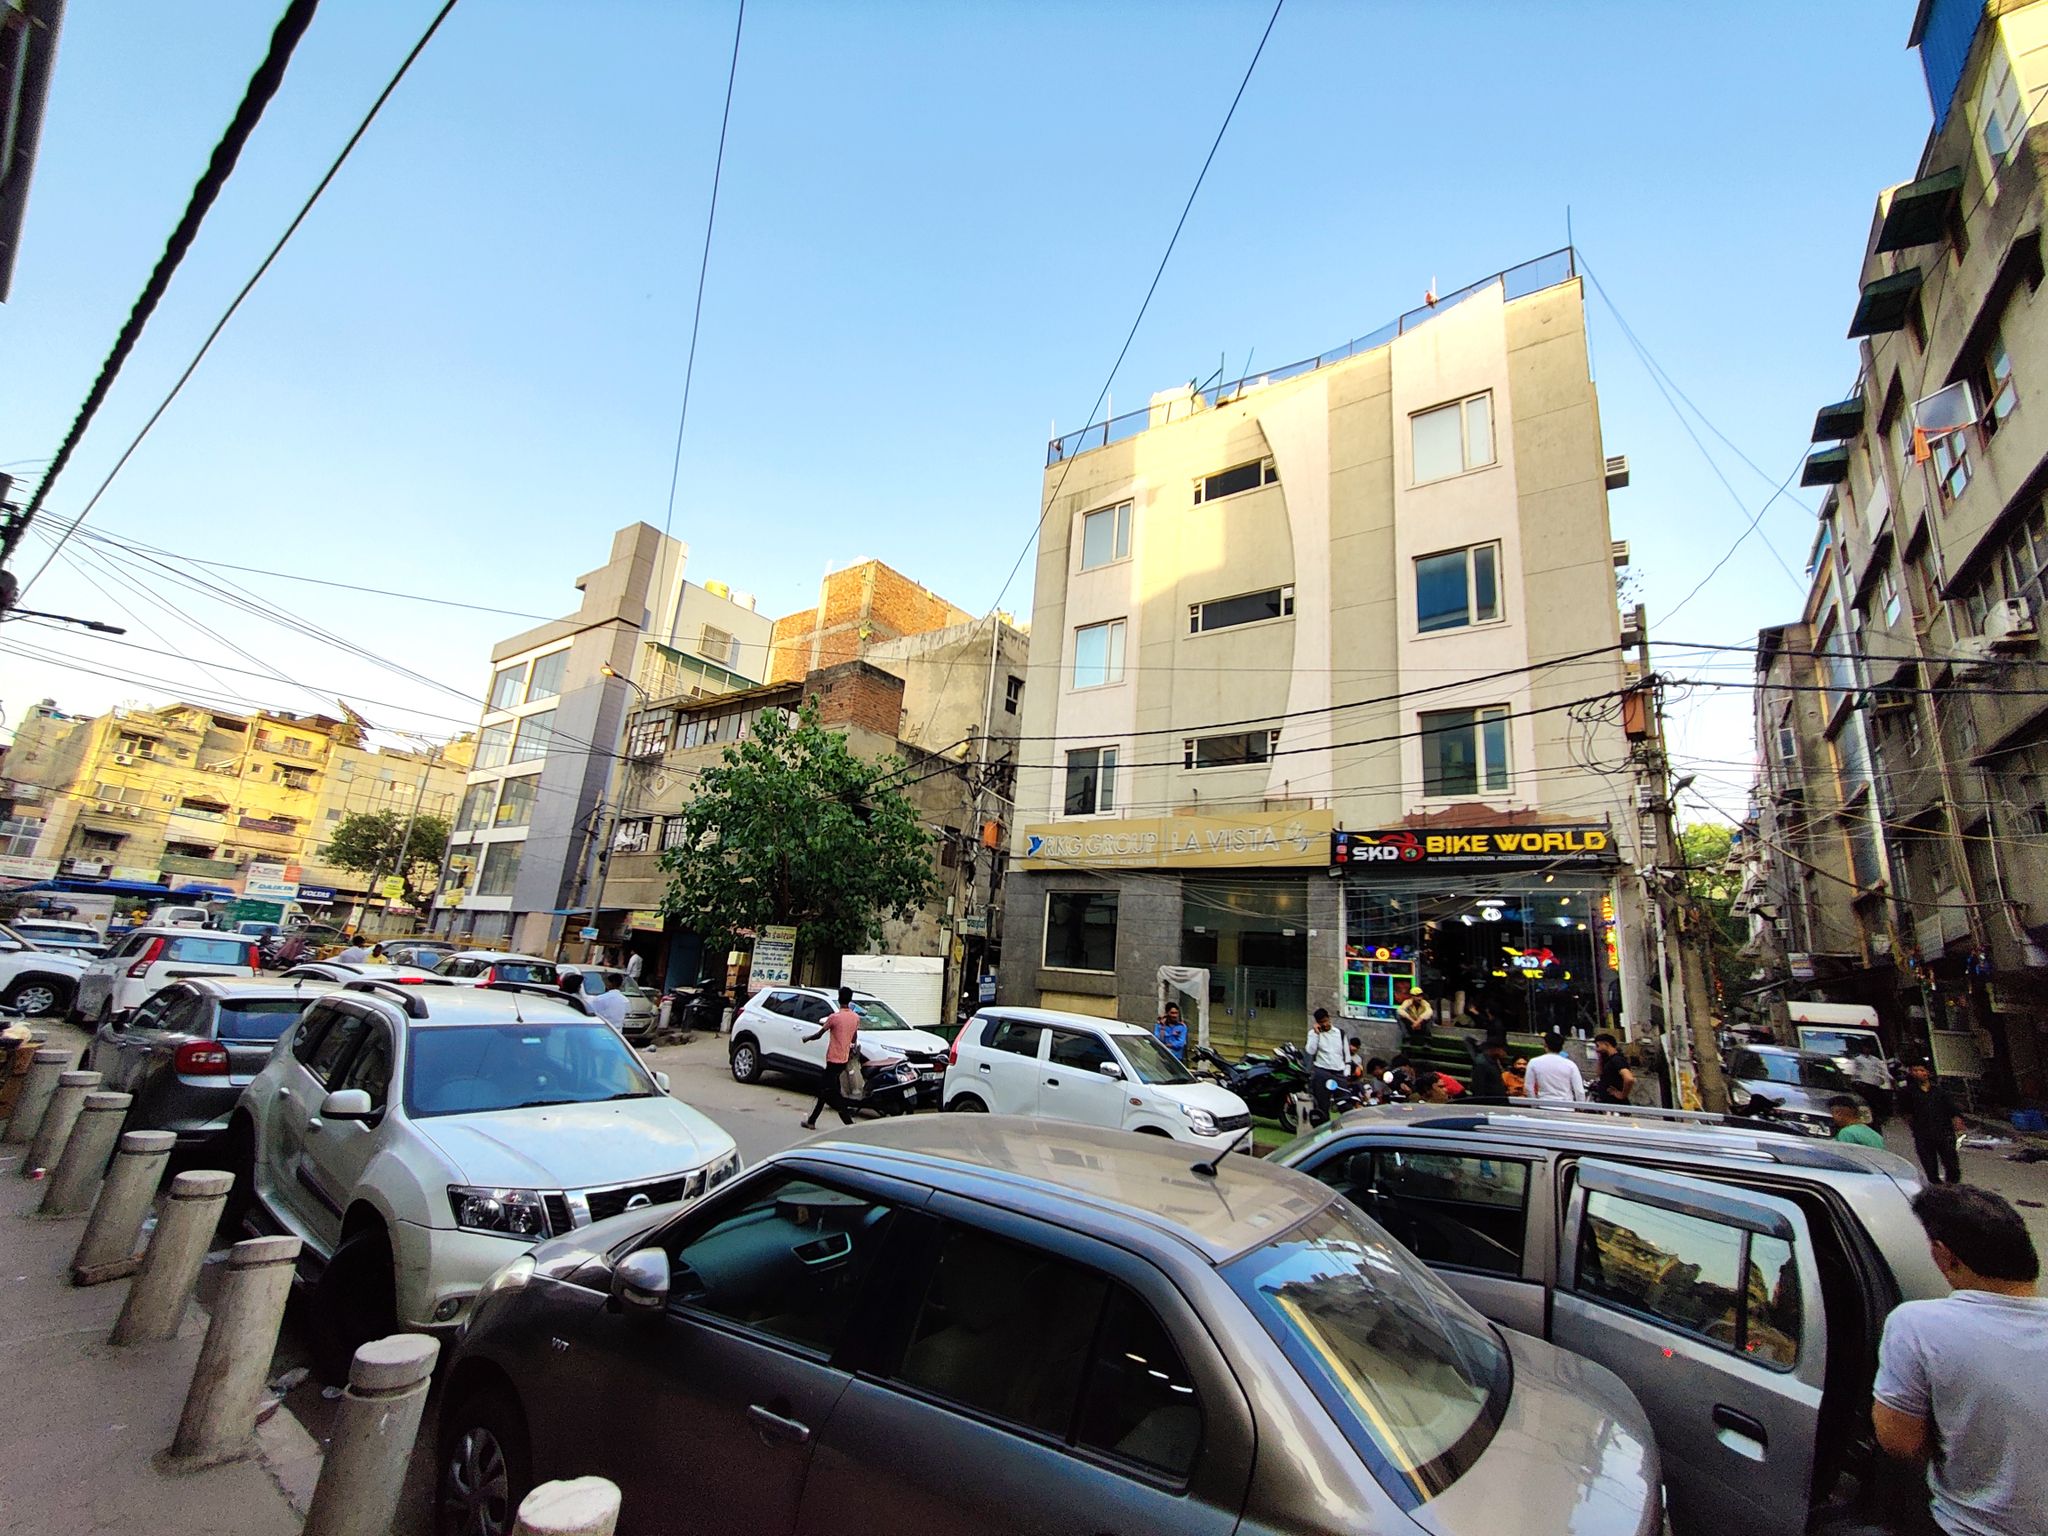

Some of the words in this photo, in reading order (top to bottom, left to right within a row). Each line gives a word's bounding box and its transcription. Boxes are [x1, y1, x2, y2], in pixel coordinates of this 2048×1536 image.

[1044, 834, 1082, 857] RKG
[1085, 831, 1158, 855] GROUP
[1171, 830, 1202, 853] LA
[1205, 826, 1281, 855] VISTA
[1426, 834, 1490, 854] BIKE
[1493, 830, 1607, 853] WORLD
[1352, 846, 1399, 861] SKD
[257, 883, 294, 891] DAIKIN
[301, 889, 331, 899] VOLTAS
